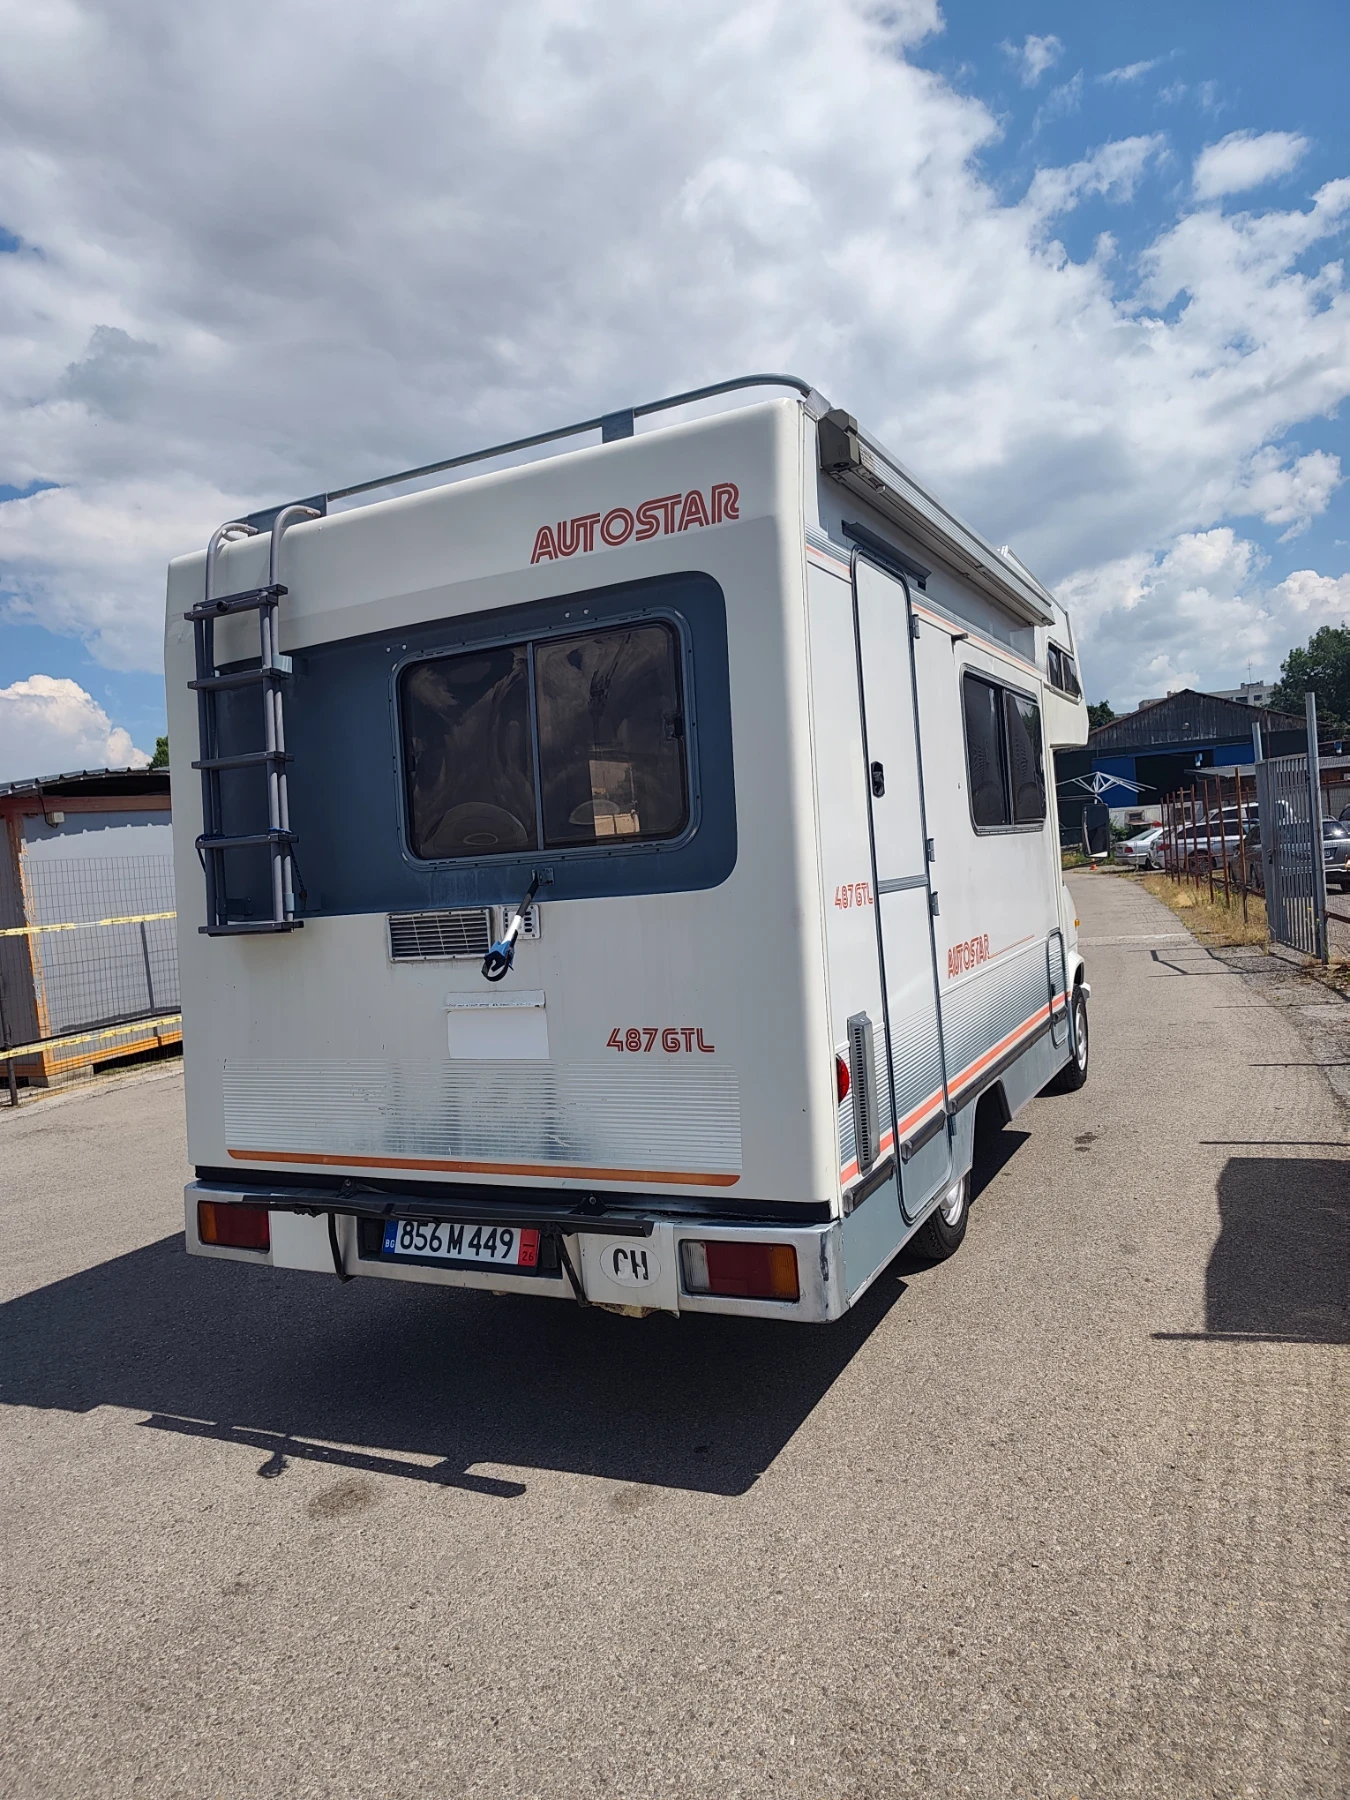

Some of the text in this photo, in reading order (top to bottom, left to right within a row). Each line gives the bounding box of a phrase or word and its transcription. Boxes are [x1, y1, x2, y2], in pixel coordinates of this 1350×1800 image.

[529, 482, 740, 565] AUTOSTAR
[947, 933, 990, 980] AUTOSTAR
[384, 1239, 396, 1249] BG
[521, 1251, 534, 1262] 26
[612, 1247, 649, 1281] CH
